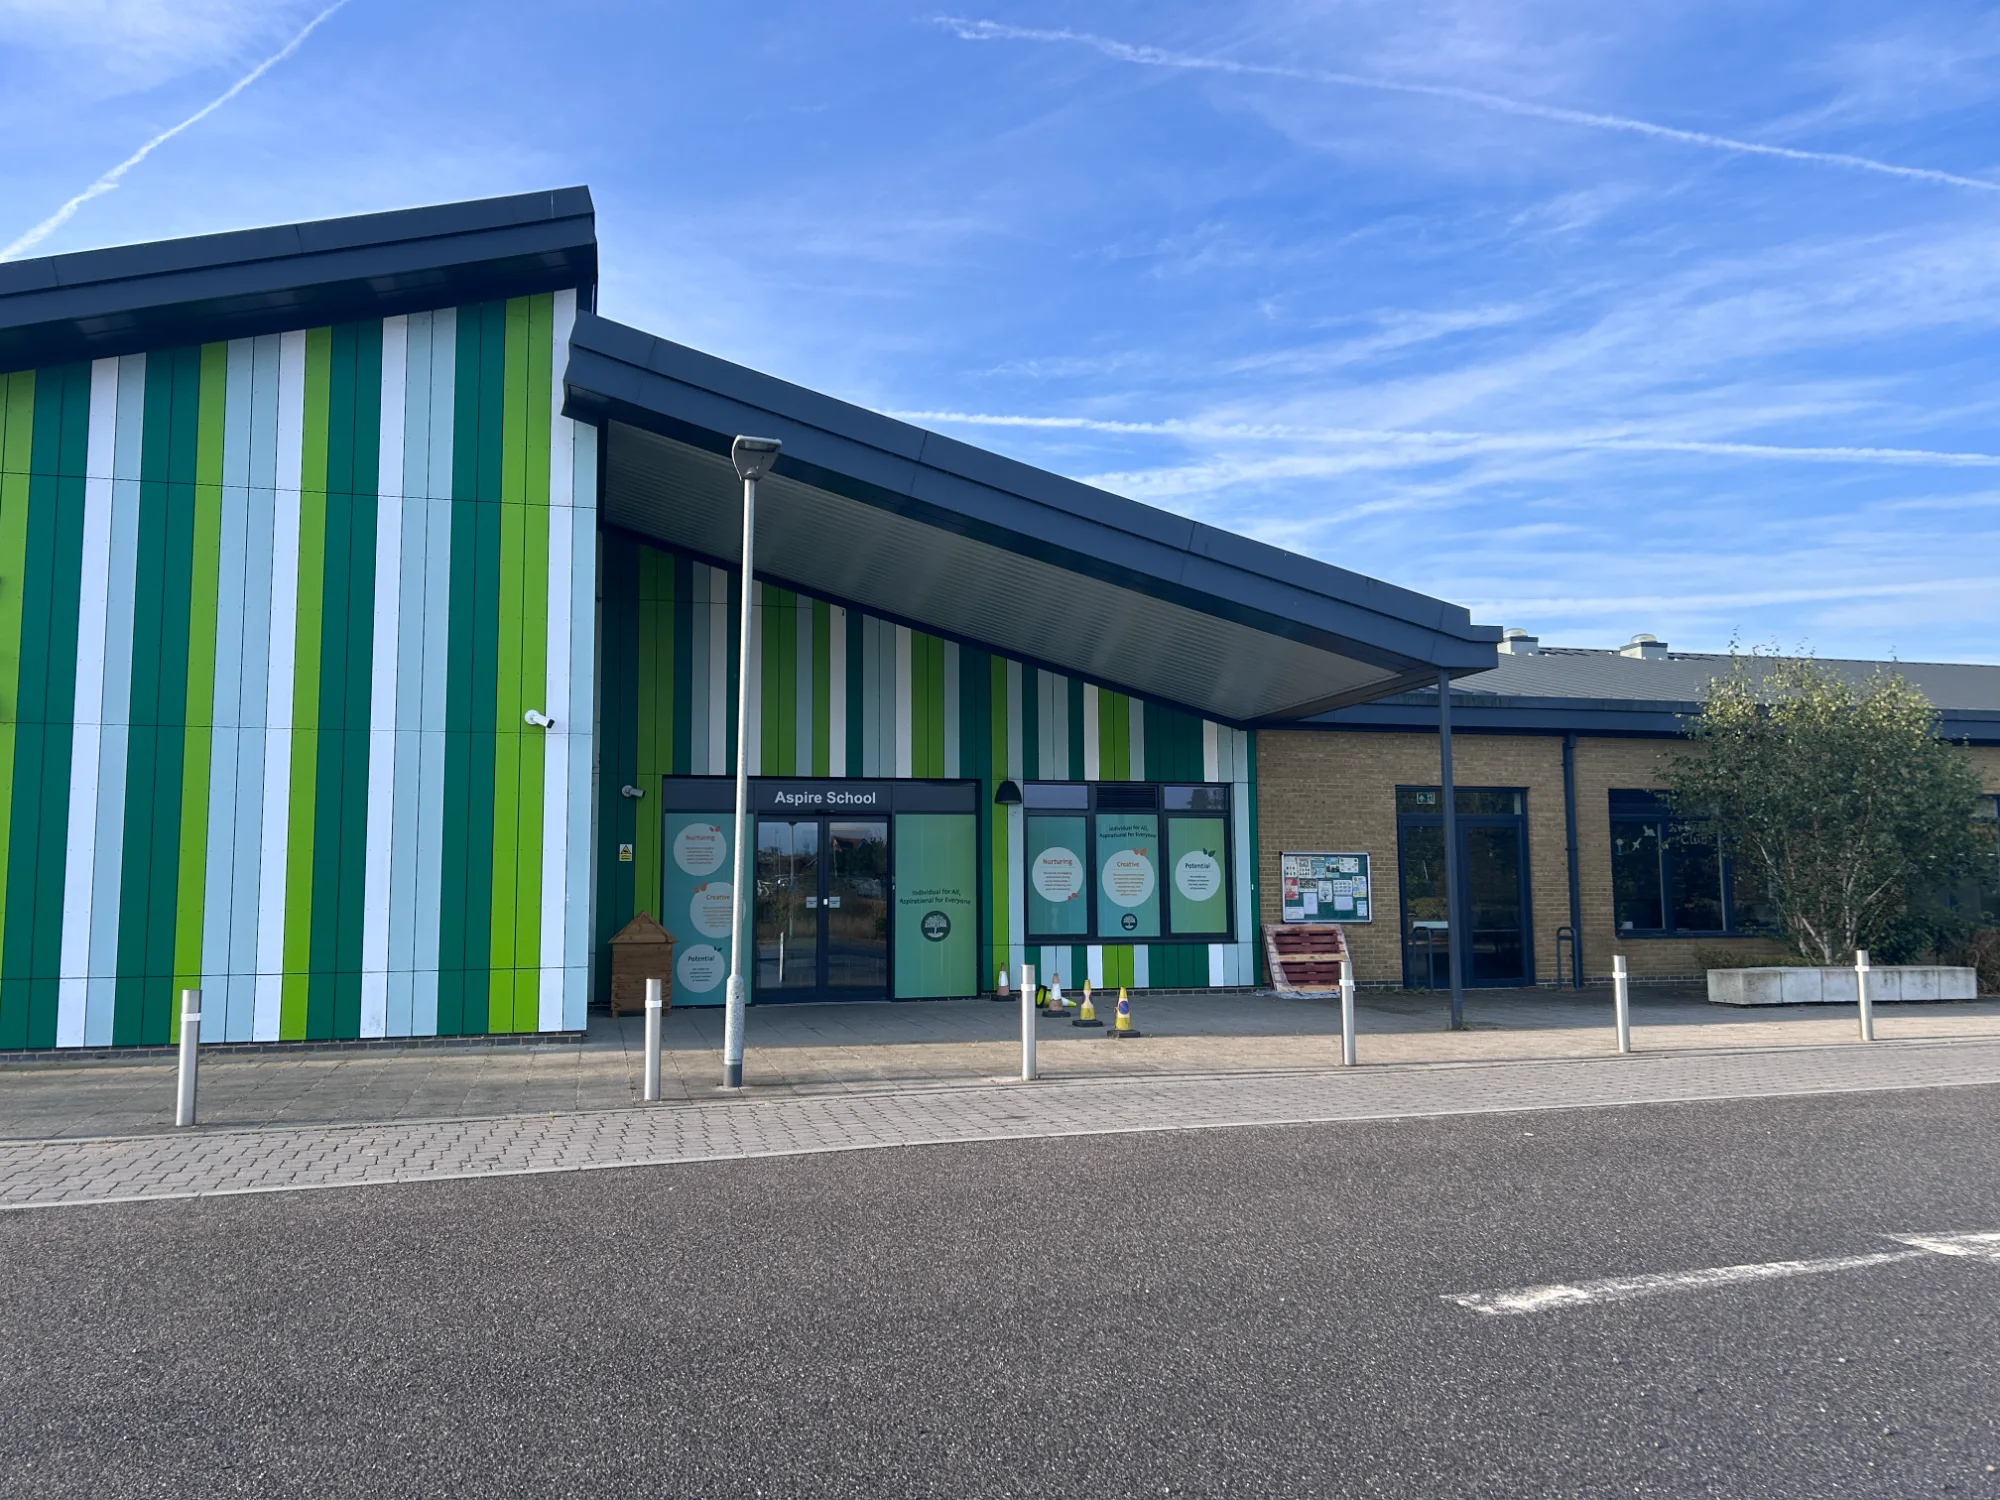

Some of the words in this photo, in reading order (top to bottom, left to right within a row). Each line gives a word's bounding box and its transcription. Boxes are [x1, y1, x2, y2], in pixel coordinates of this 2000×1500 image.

[774, 791, 822, 806] Aspire
[826, 791, 876, 804] School
[1042, 858, 1073, 866] Nurturing
[912, 888, 941, 896] Individual
[899, 897, 935, 905] Aspirational
[944, 897, 971, 905] Everyone
